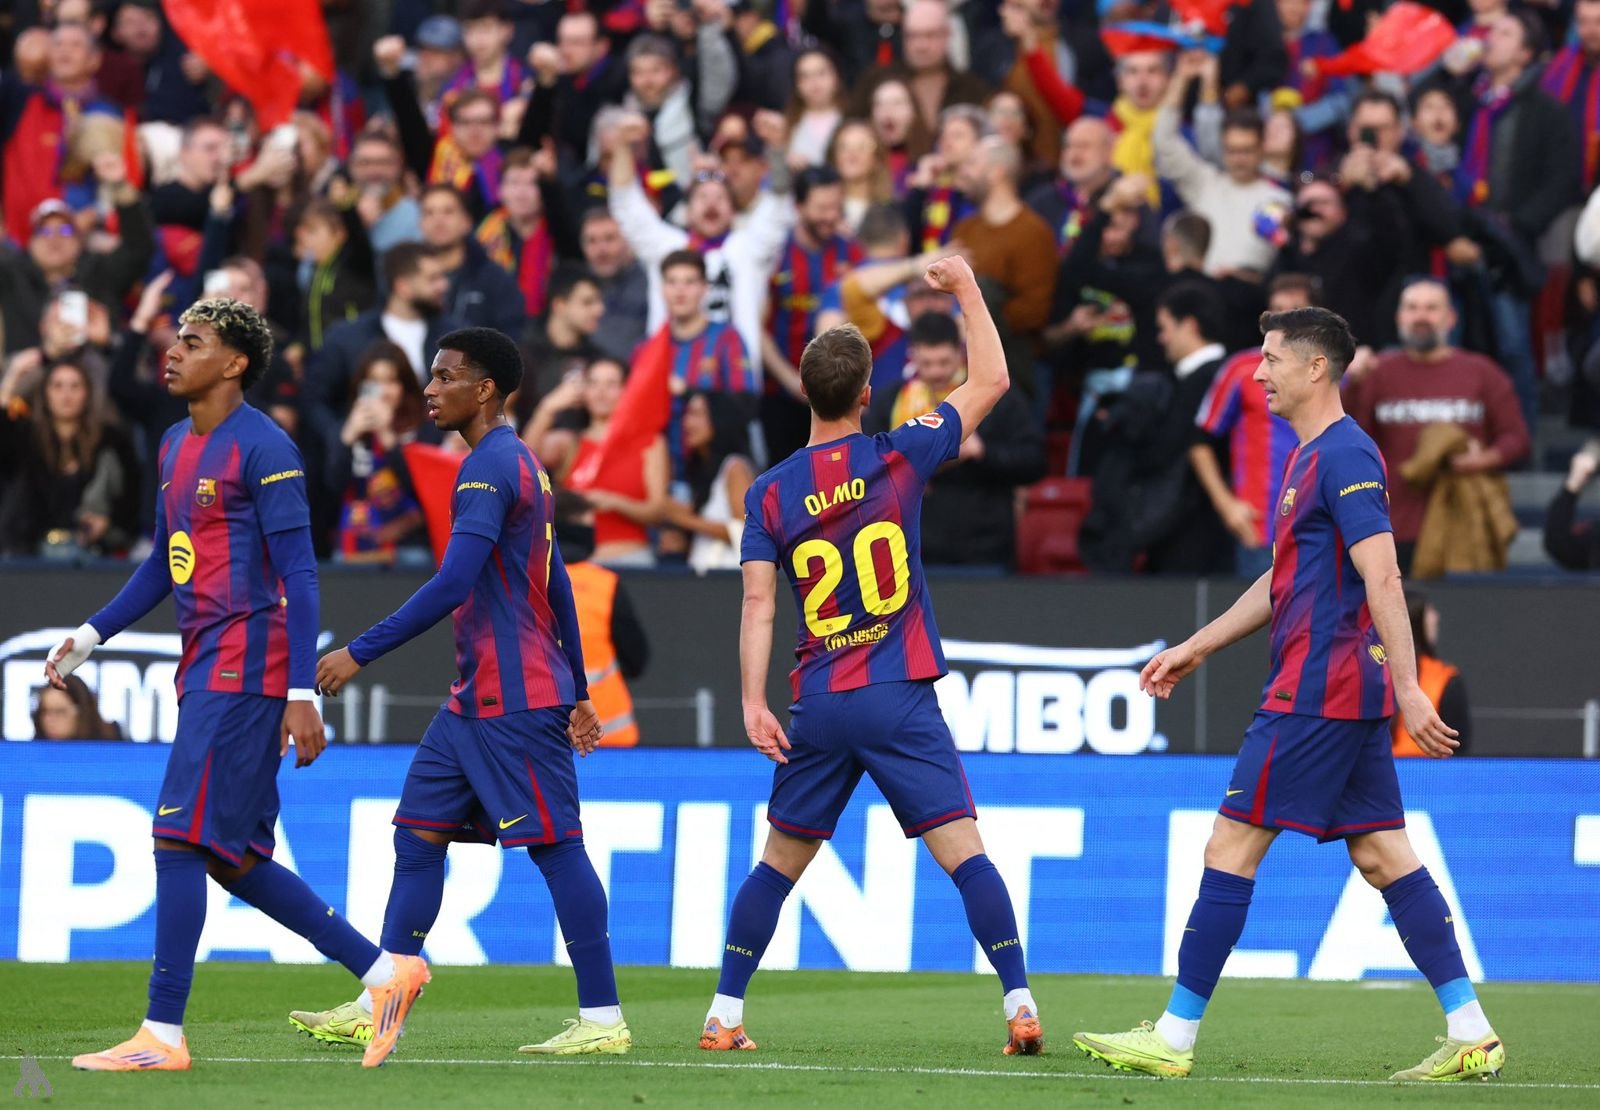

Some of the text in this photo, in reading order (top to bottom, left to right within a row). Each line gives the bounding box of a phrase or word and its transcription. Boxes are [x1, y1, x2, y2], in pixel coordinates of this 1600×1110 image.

[804, 478, 866, 516] OLMO
[1339, 481, 1378, 497] AMBILIGHT
[792, 520, 911, 638] 20
[1162, 810, 1486, 983] LA
